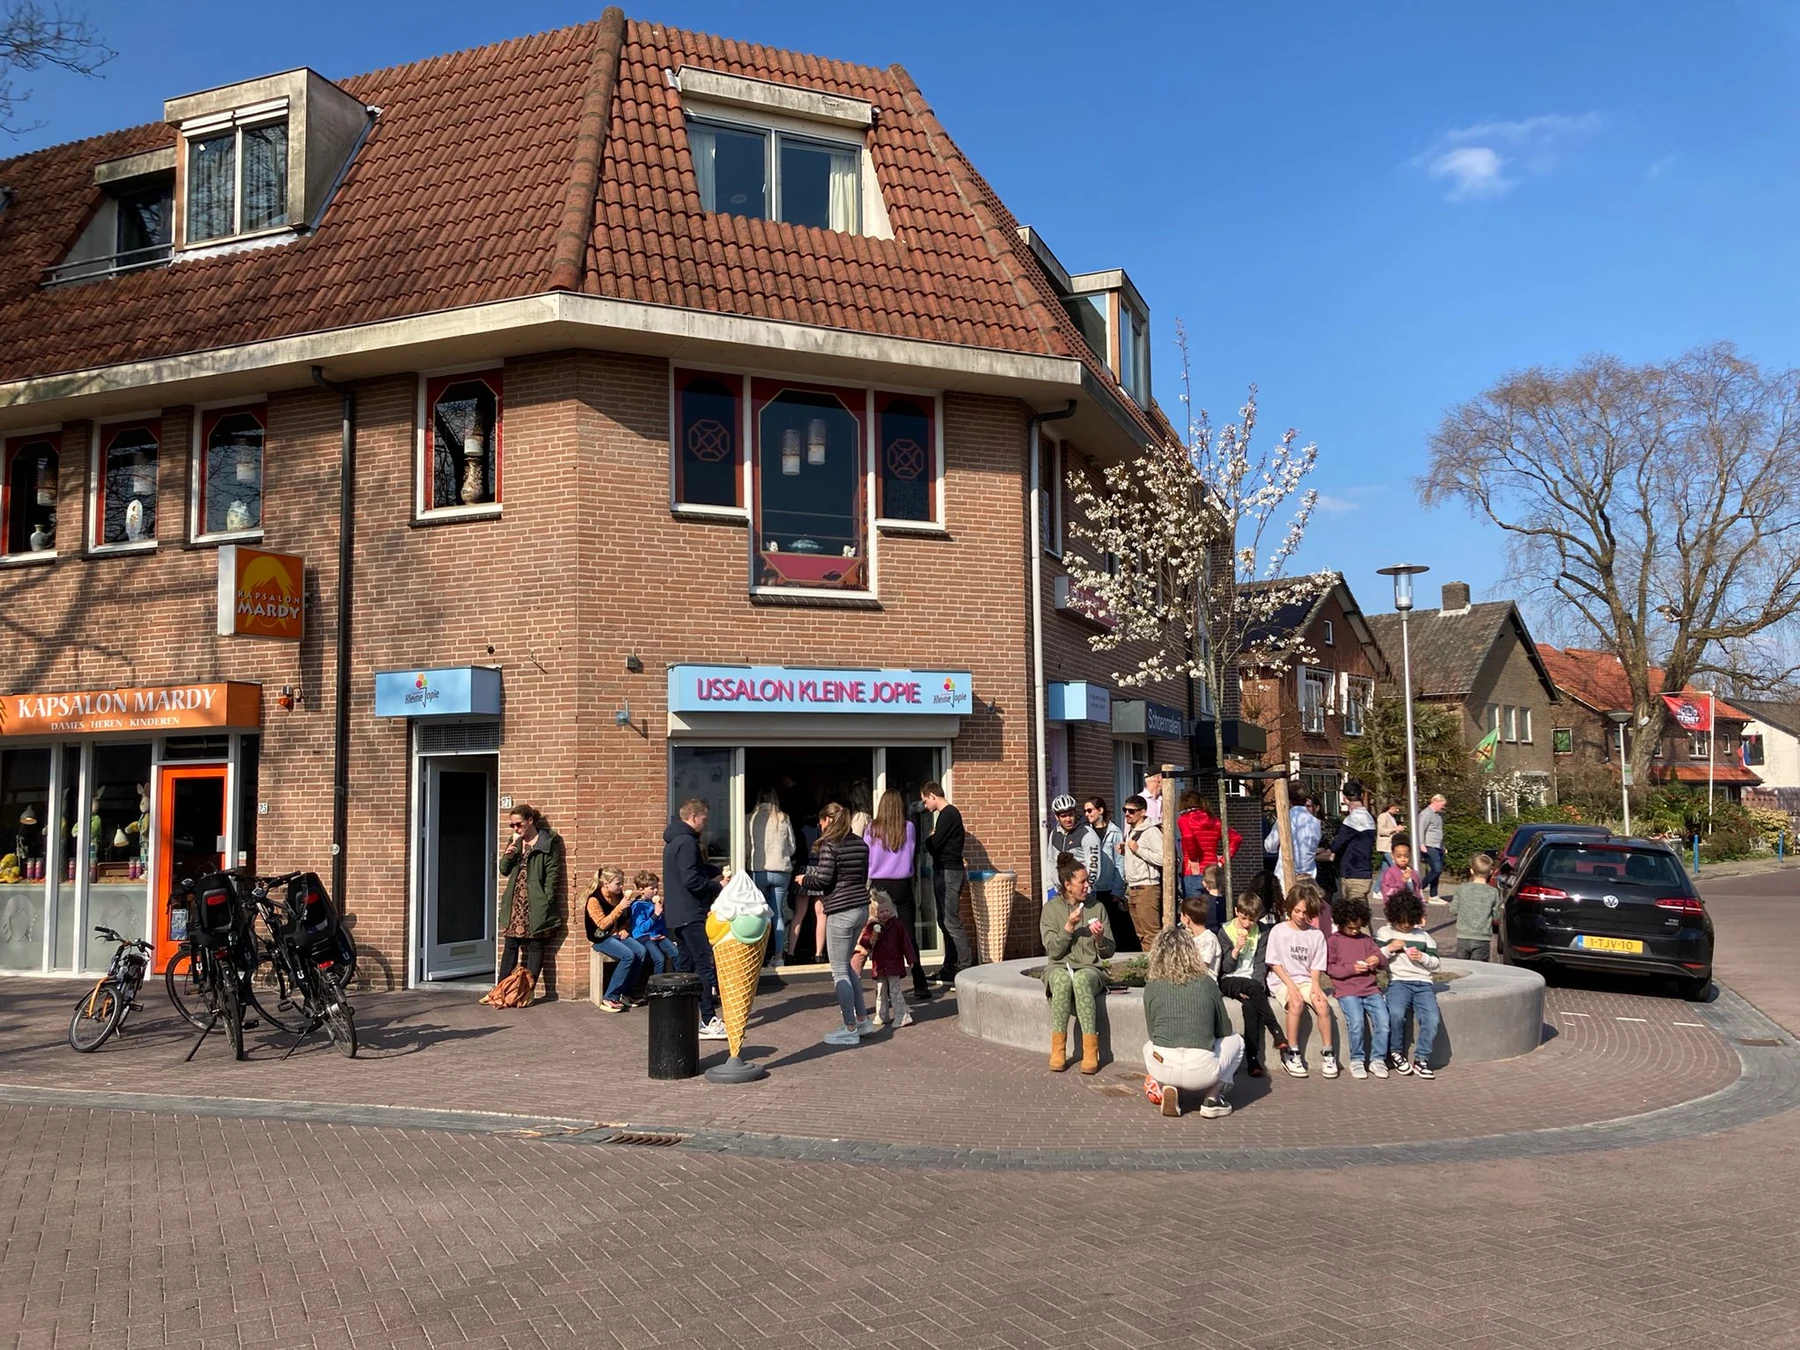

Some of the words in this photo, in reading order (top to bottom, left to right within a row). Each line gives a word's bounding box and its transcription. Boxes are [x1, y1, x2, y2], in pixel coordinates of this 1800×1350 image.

[238, 591, 300, 604] KAPSALON
[238, 601, 300, 619] MARDY
[697, 678, 793, 702] IJSSALON
[799, 679, 866, 703] KLEINE
[869, 681, 921, 703] JOPIE
[18, 691, 128, 718] KAPSALON
[134, 688, 217, 712] MARDY
[51, 721, 85, 731] DAMES
[91, 719, 123, 729] HEREN
[129, 716, 180, 728] KINDEREN
[502, 797, 511, 808] 27
[1090, 844, 1099, 855] IT.
[1090, 855, 1099, 869] DO
[1590, 938, 1634, 950] 1-TJV-10
